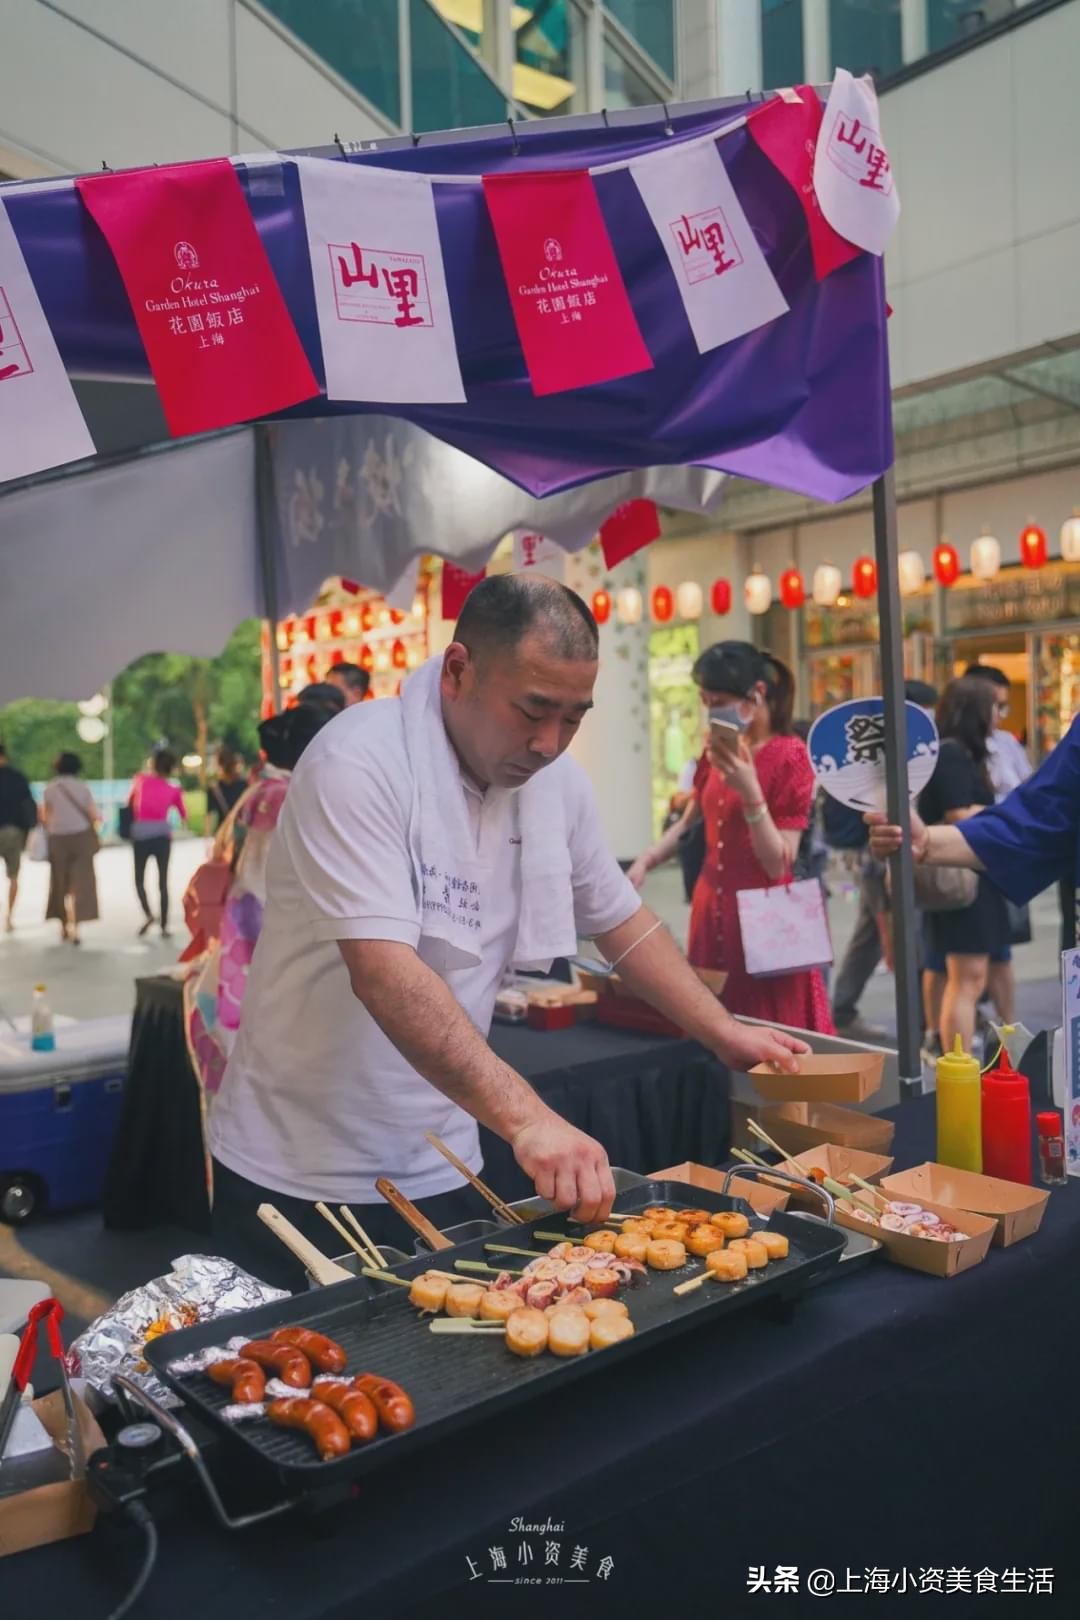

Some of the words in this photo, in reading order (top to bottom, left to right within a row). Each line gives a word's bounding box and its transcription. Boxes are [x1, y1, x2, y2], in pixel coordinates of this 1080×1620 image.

[837, 118, 889, 190] 山里
[677, 214, 735, 275] 山里
[145, 297, 181, 312] Garden
[181, 294, 208, 309] Hotel
[209, 283, 260, 303] Shanghai
[170, 271, 220, 294] Okura
[337, 241, 424, 328] 山里
[198, 332, 225, 349] 上海
